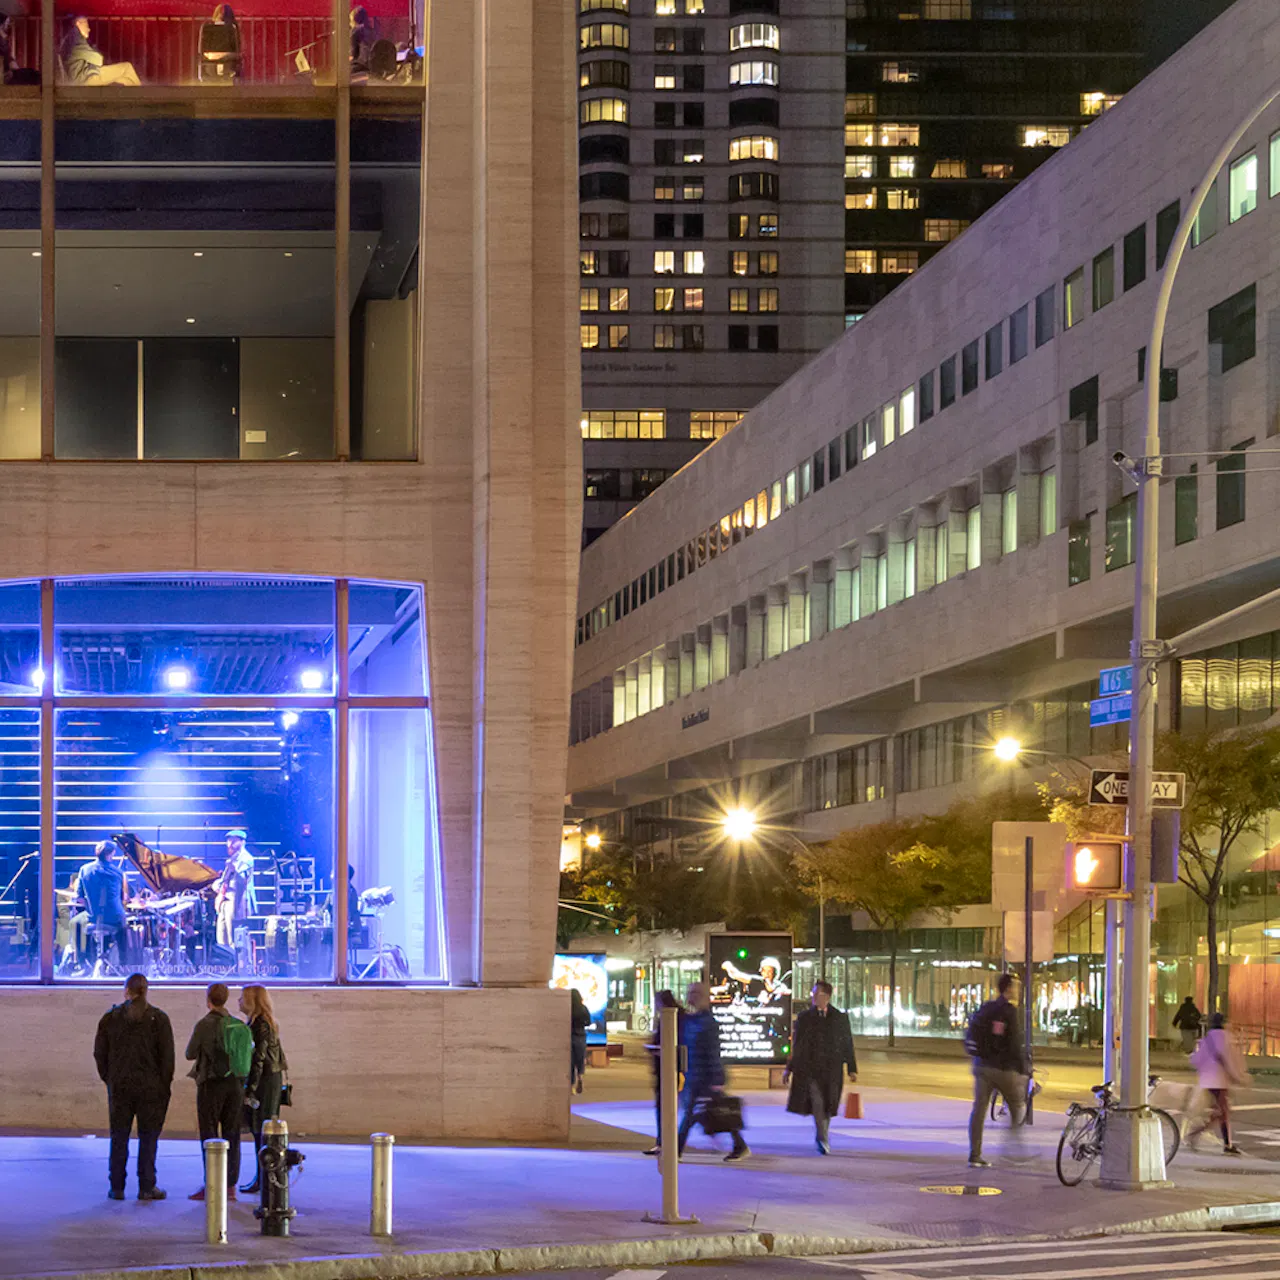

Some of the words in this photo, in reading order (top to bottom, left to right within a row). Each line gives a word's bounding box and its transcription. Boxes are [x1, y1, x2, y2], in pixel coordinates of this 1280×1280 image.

[1110, 671, 1121, 690] 65
[1103, 779, 1128, 796] ONE
[1151, 783, 1172, 798] AY
